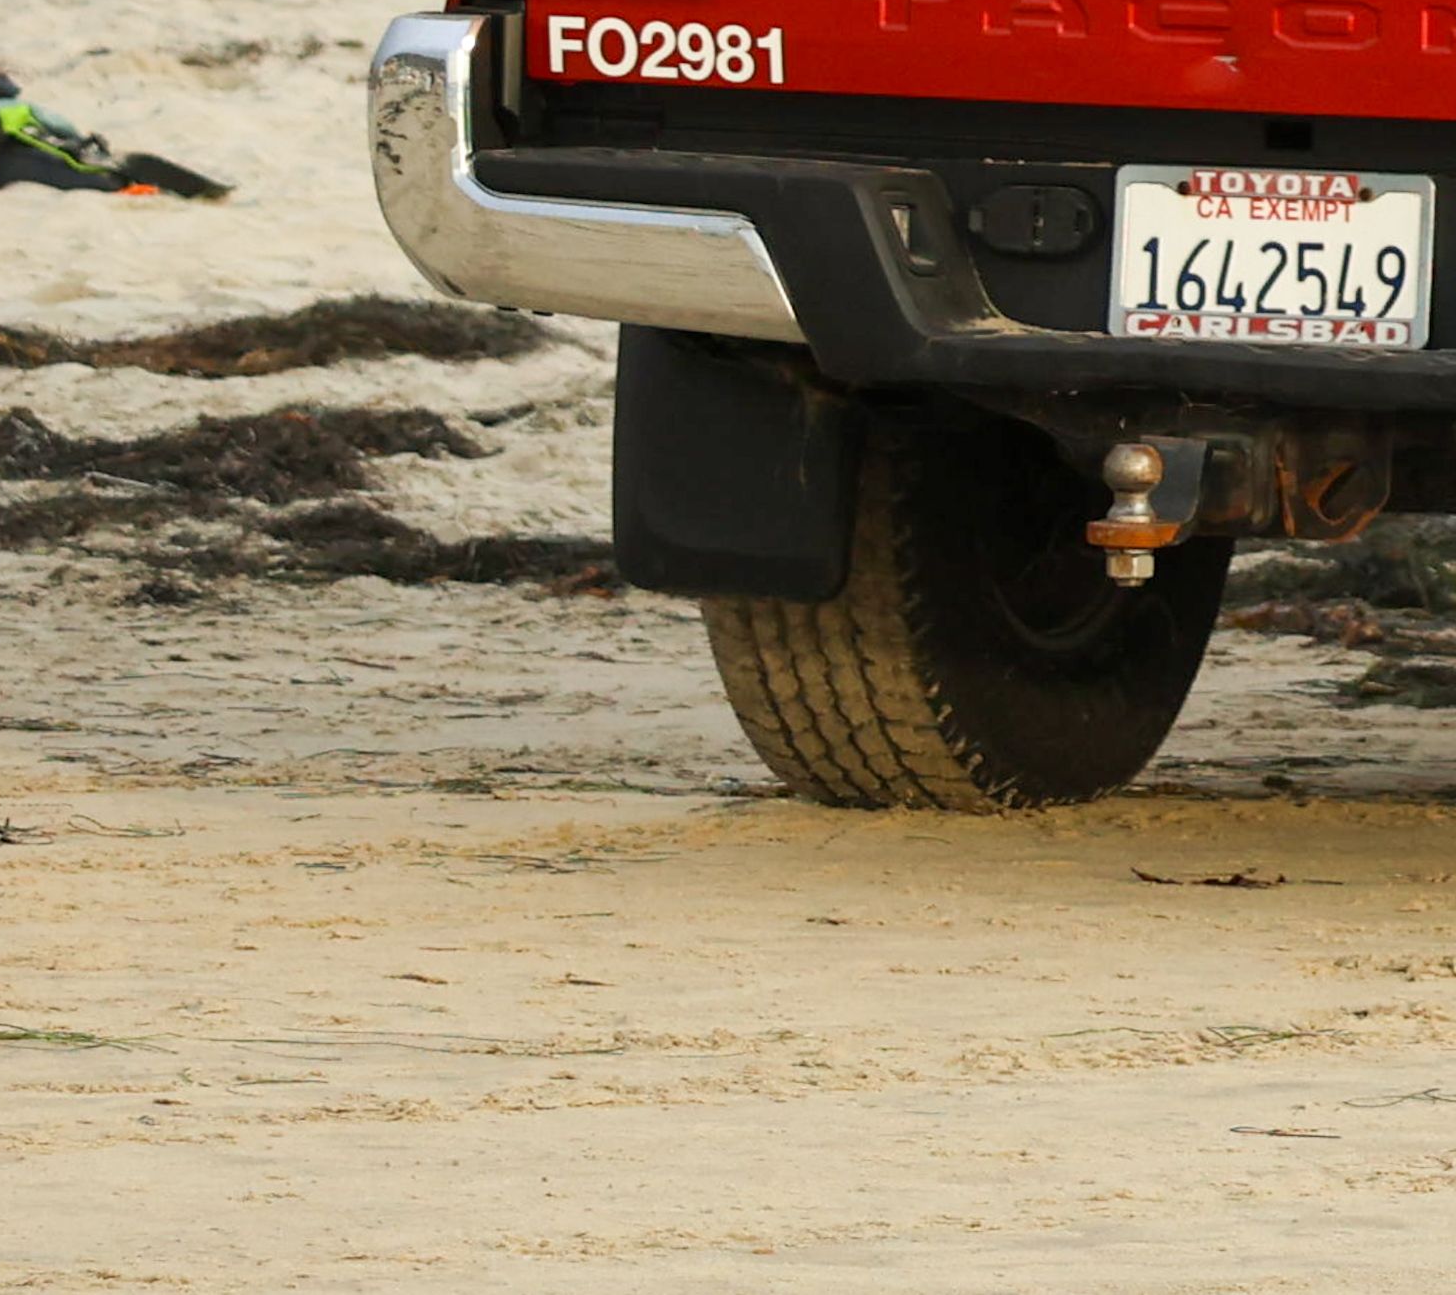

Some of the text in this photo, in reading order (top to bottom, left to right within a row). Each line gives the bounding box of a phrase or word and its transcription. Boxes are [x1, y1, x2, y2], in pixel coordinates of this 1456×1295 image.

[547, 14, 785, 85] FO2981
[1194, 171, 1354, 198] TOYOTA
[1197, 196, 1354, 223] CA EXEMPT
[1136, 237, 1407, 318] 1642549
[1126, 313, 1409, 346] CARLSBAD
